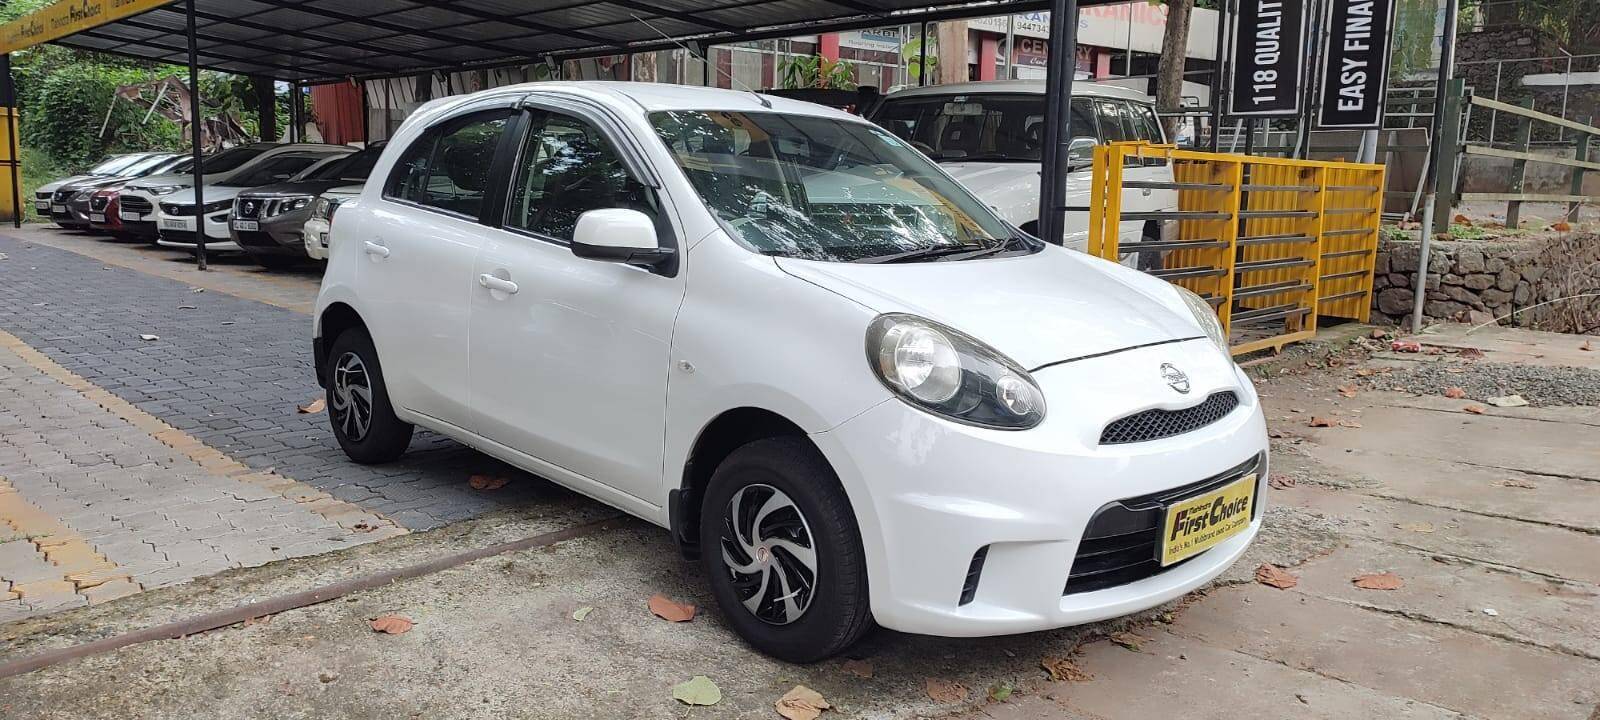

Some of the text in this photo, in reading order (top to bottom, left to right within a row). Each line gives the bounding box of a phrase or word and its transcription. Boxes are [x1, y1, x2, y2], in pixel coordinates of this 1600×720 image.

[1252, 69, 1278, 105] 118
[1338, 0, 1375, 111] EASY FINA
